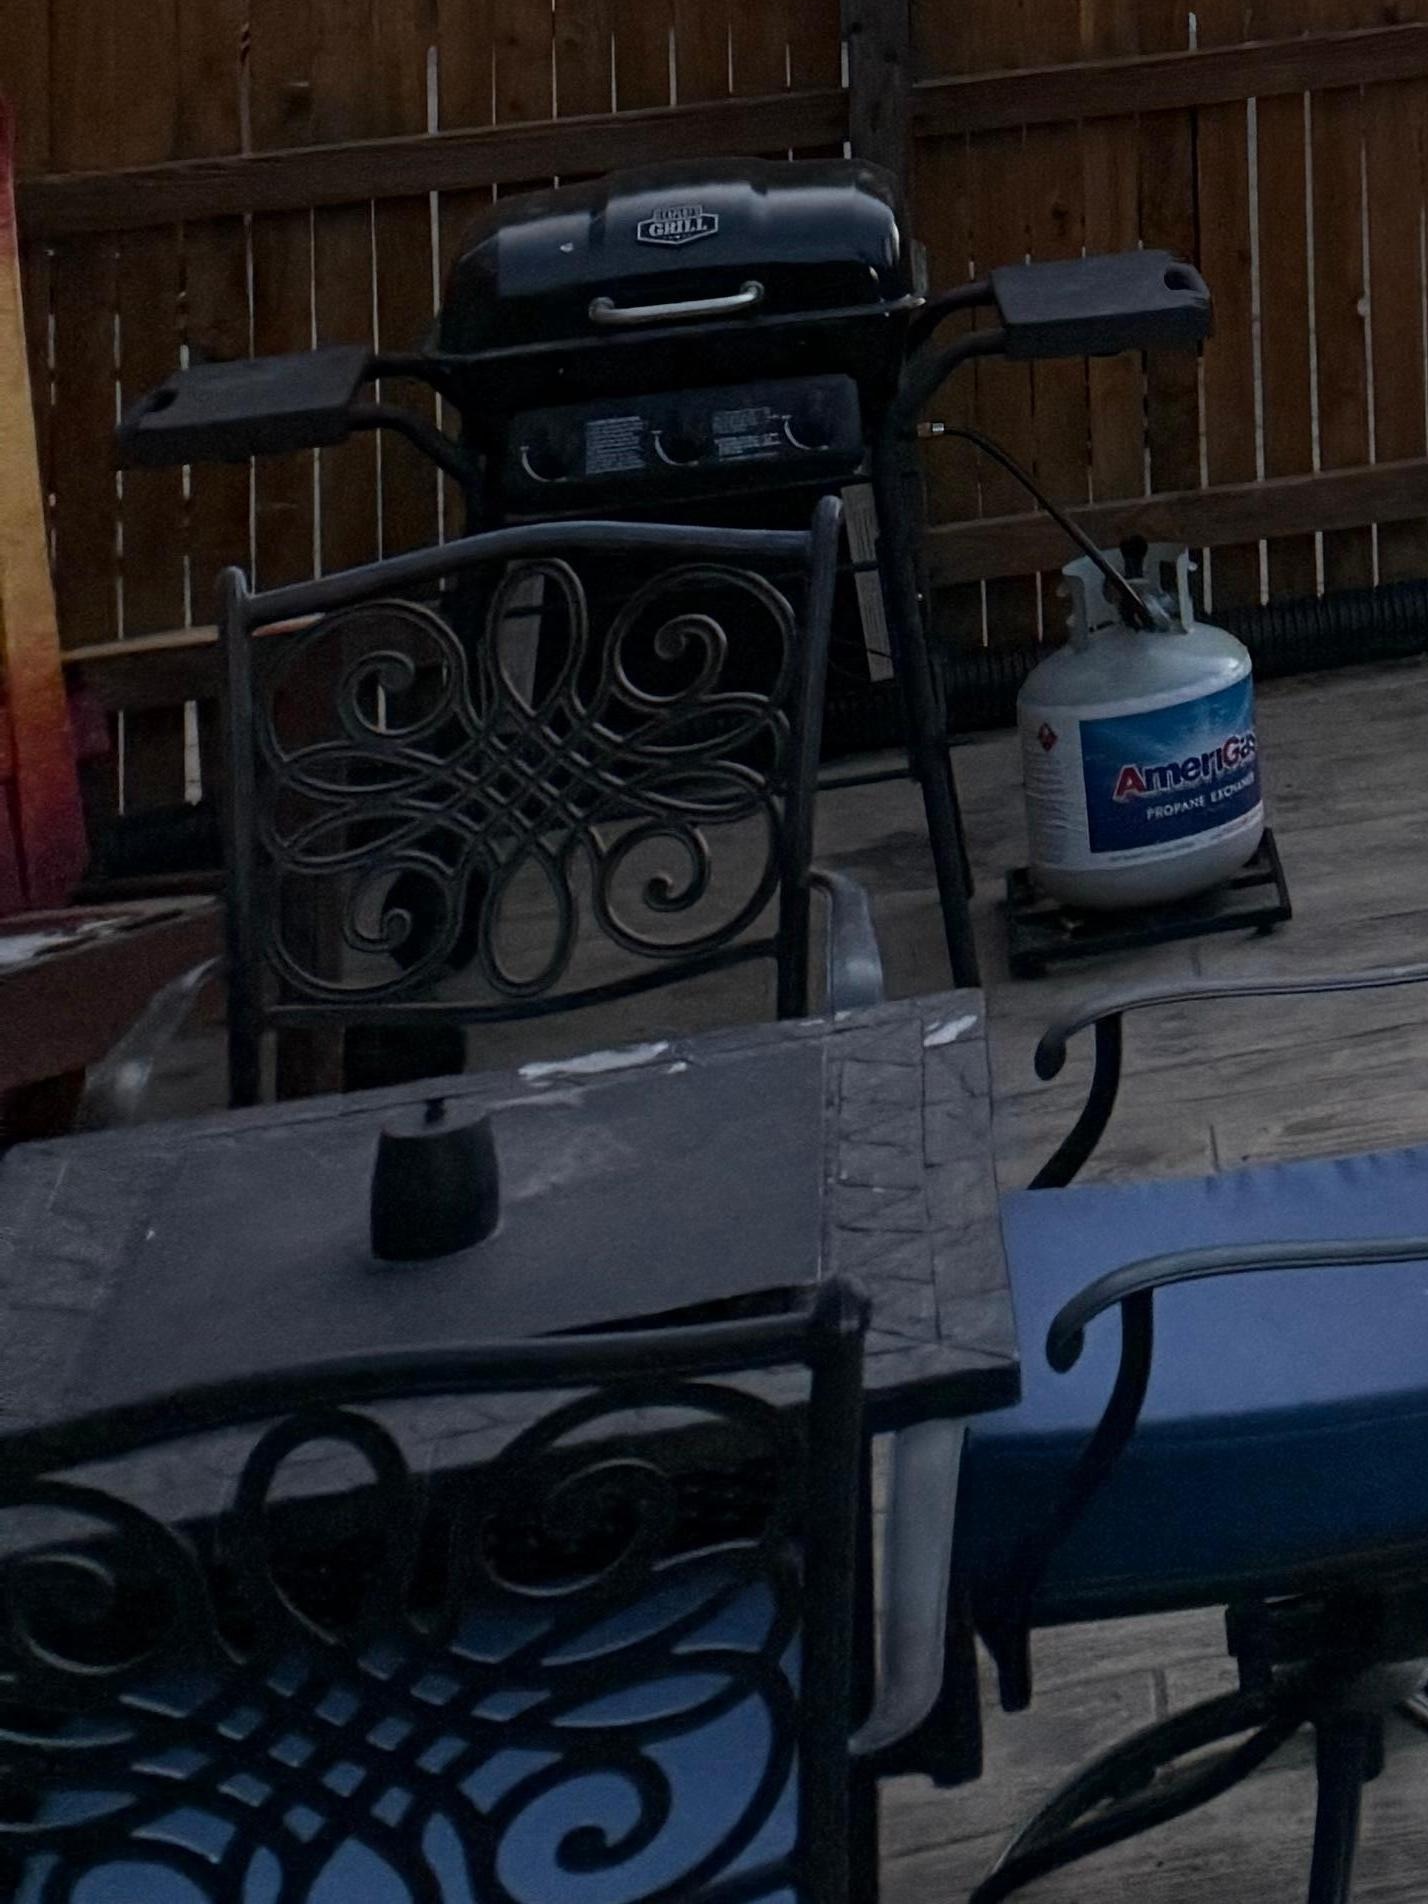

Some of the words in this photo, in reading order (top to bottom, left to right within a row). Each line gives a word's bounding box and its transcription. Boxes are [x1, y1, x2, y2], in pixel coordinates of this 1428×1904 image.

[648, 217, 708, 237] GRILL
[1146, 794, 1206, 821] PROPANE
[1210, 770, 1255, 803] EXCHAN
